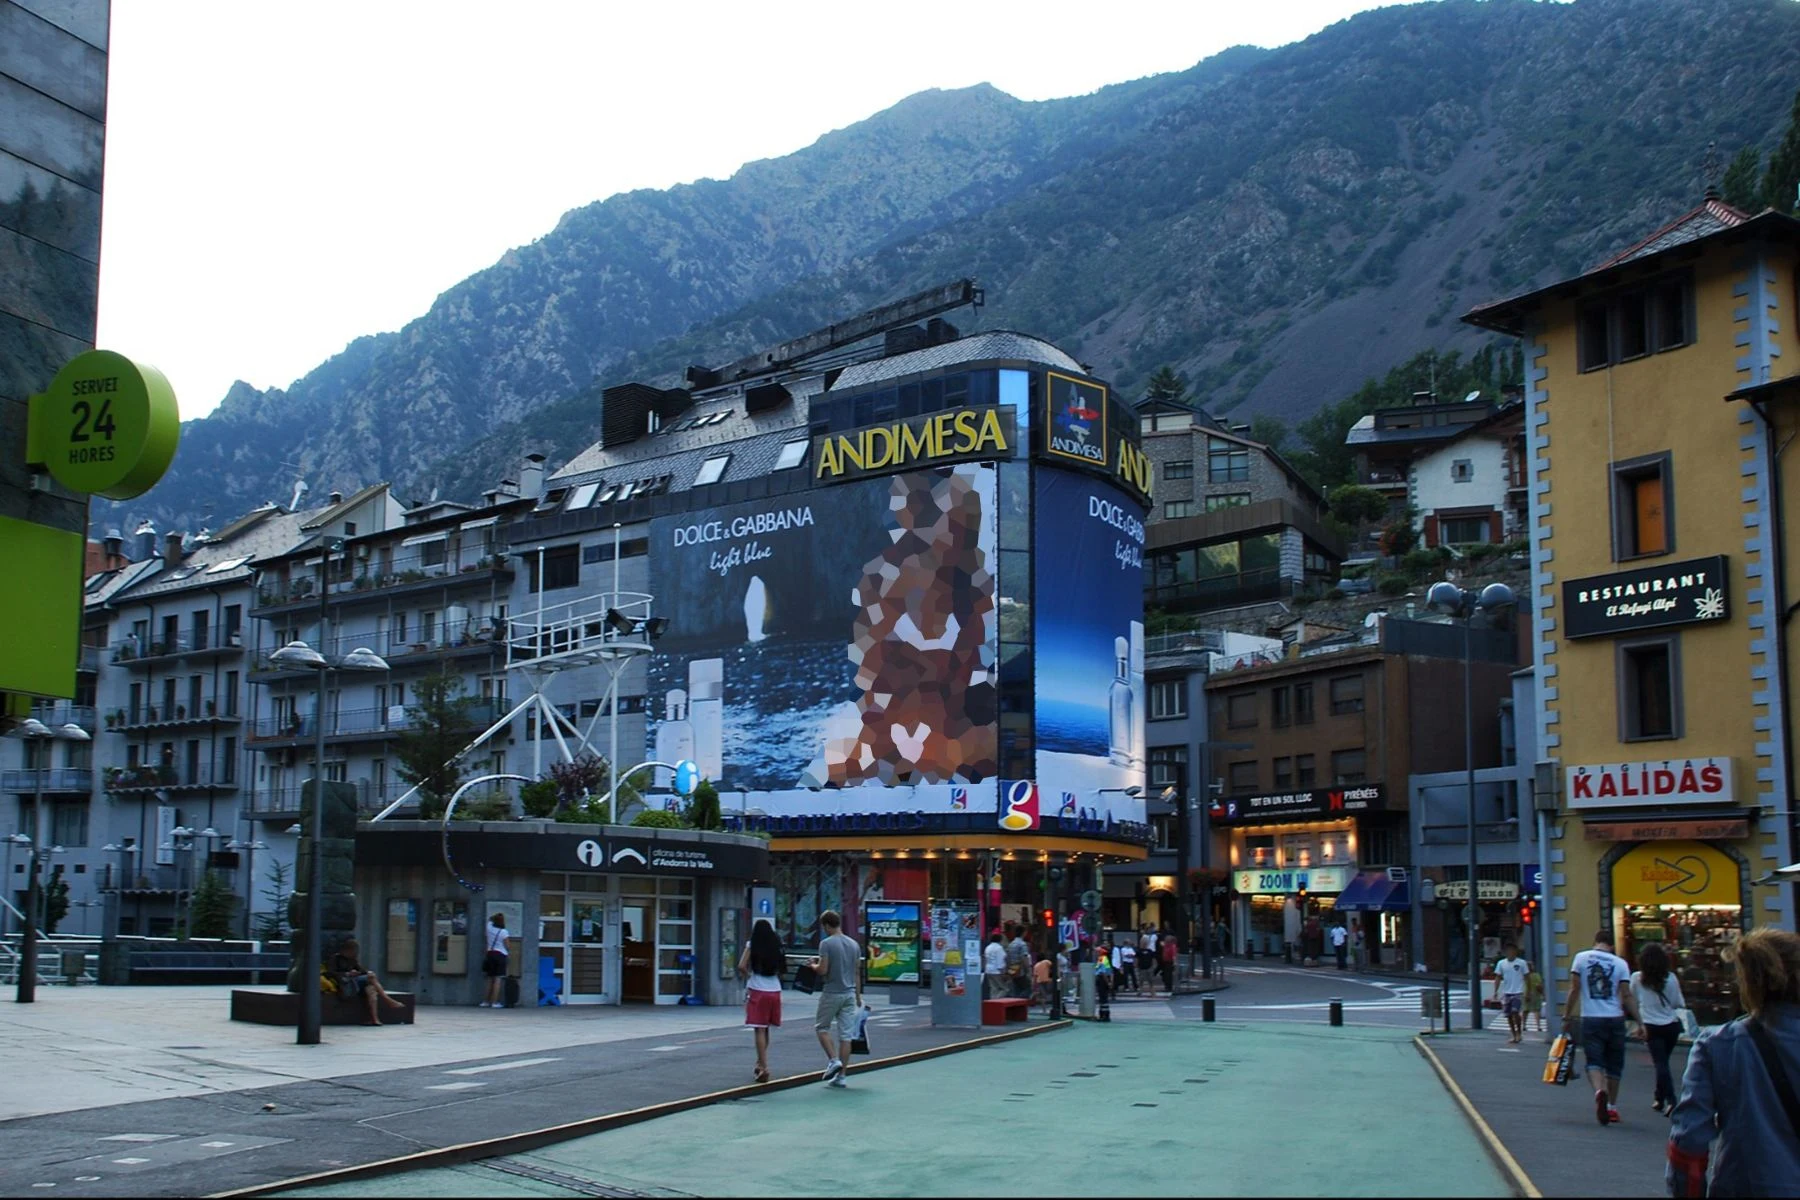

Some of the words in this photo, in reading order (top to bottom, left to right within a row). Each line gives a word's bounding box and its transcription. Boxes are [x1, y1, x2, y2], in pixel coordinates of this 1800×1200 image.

[72, 376, 118, 396] SERVEI
[70, 399, 116, 443] 24
[816, 409, 1008, 479] ANDIMESA
[1051, 436, 1103, 460] ANDIMESA
[69, 446, 114, 464] HORES
[709, 547, 741, 577] light
[743, 541, 773, 564] blue
[1578, 572, 1706, 603] RESTAURANT
[1578, 758, 1717, 775] DIGITAL
[1573, 766, 1724, 798] KALIDAS
[652, 858, 688, 867] d'Andorra
[689, 859, 697, 867] la
[1259, 874, 1292, 889] ZOOM
[1458, 888, 1513, 898] Tanon
[870, 928, 906, 937] FAMILY
